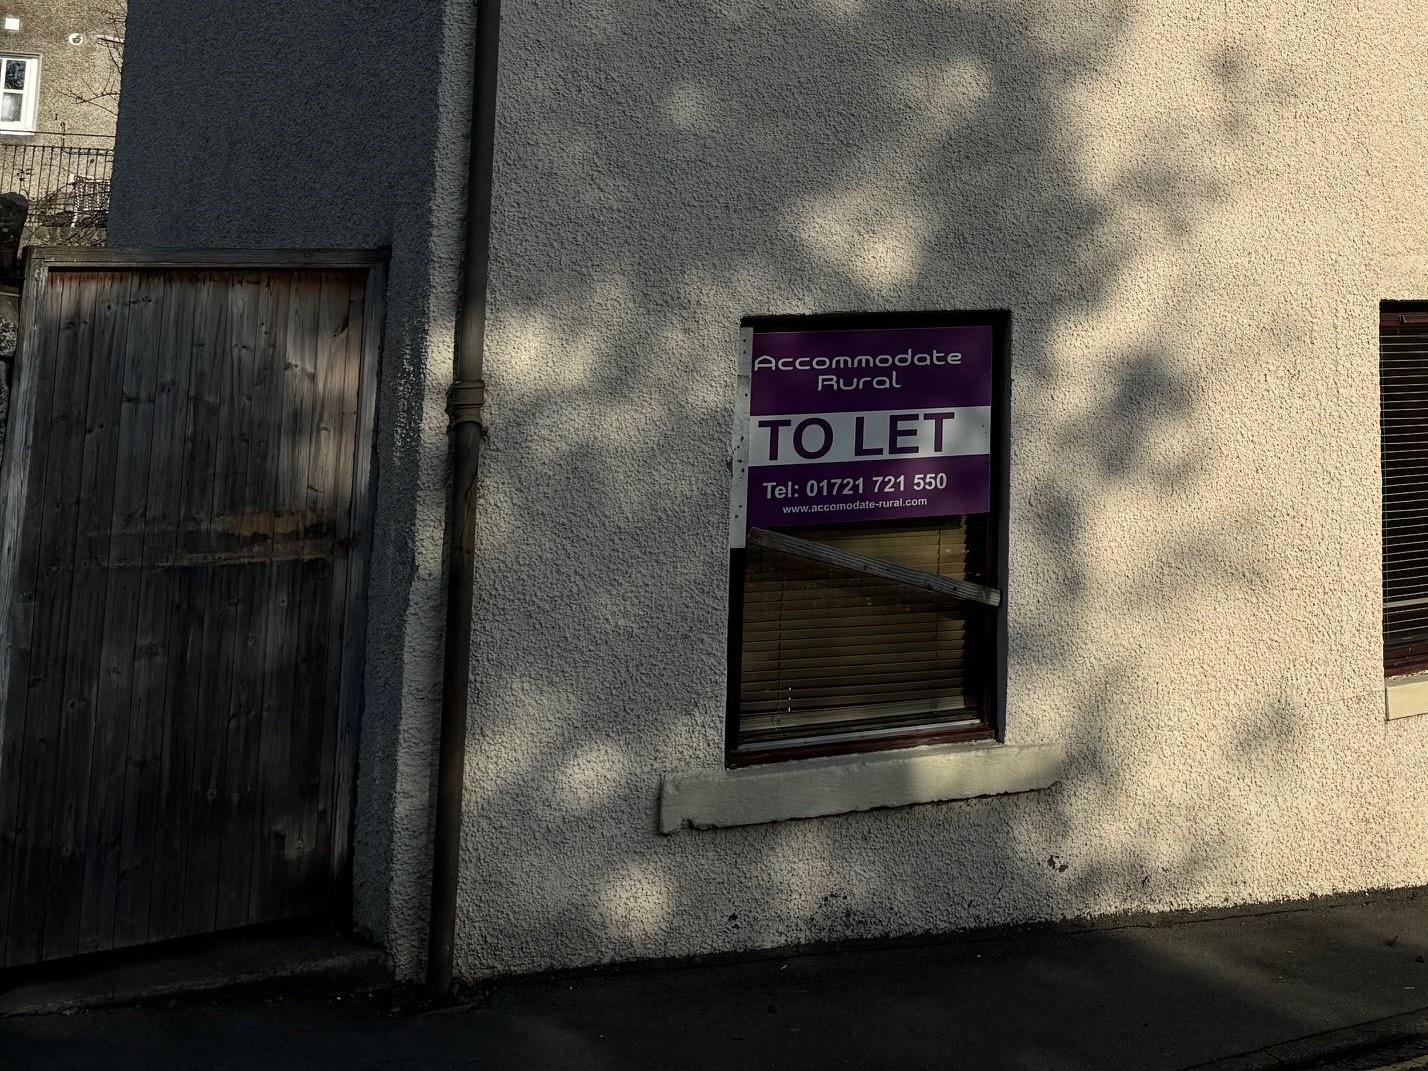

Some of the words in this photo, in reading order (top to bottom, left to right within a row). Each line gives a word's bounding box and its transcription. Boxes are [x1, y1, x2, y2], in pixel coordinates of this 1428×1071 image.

[753, 348, 962, 371] Accommodate
[817, 371, 902, 392] Rural
[758, 417, 834, 461] TO
[854, 412, 955, 457] LET
[763, 481, 799, 500] Tel:
[806, 477, 864, 497] 01721
[872, 475, 905, 493] 721
[913, 473, 947, 491] 550
[782, 497, 928, 514] www.accomodate-rural.com
